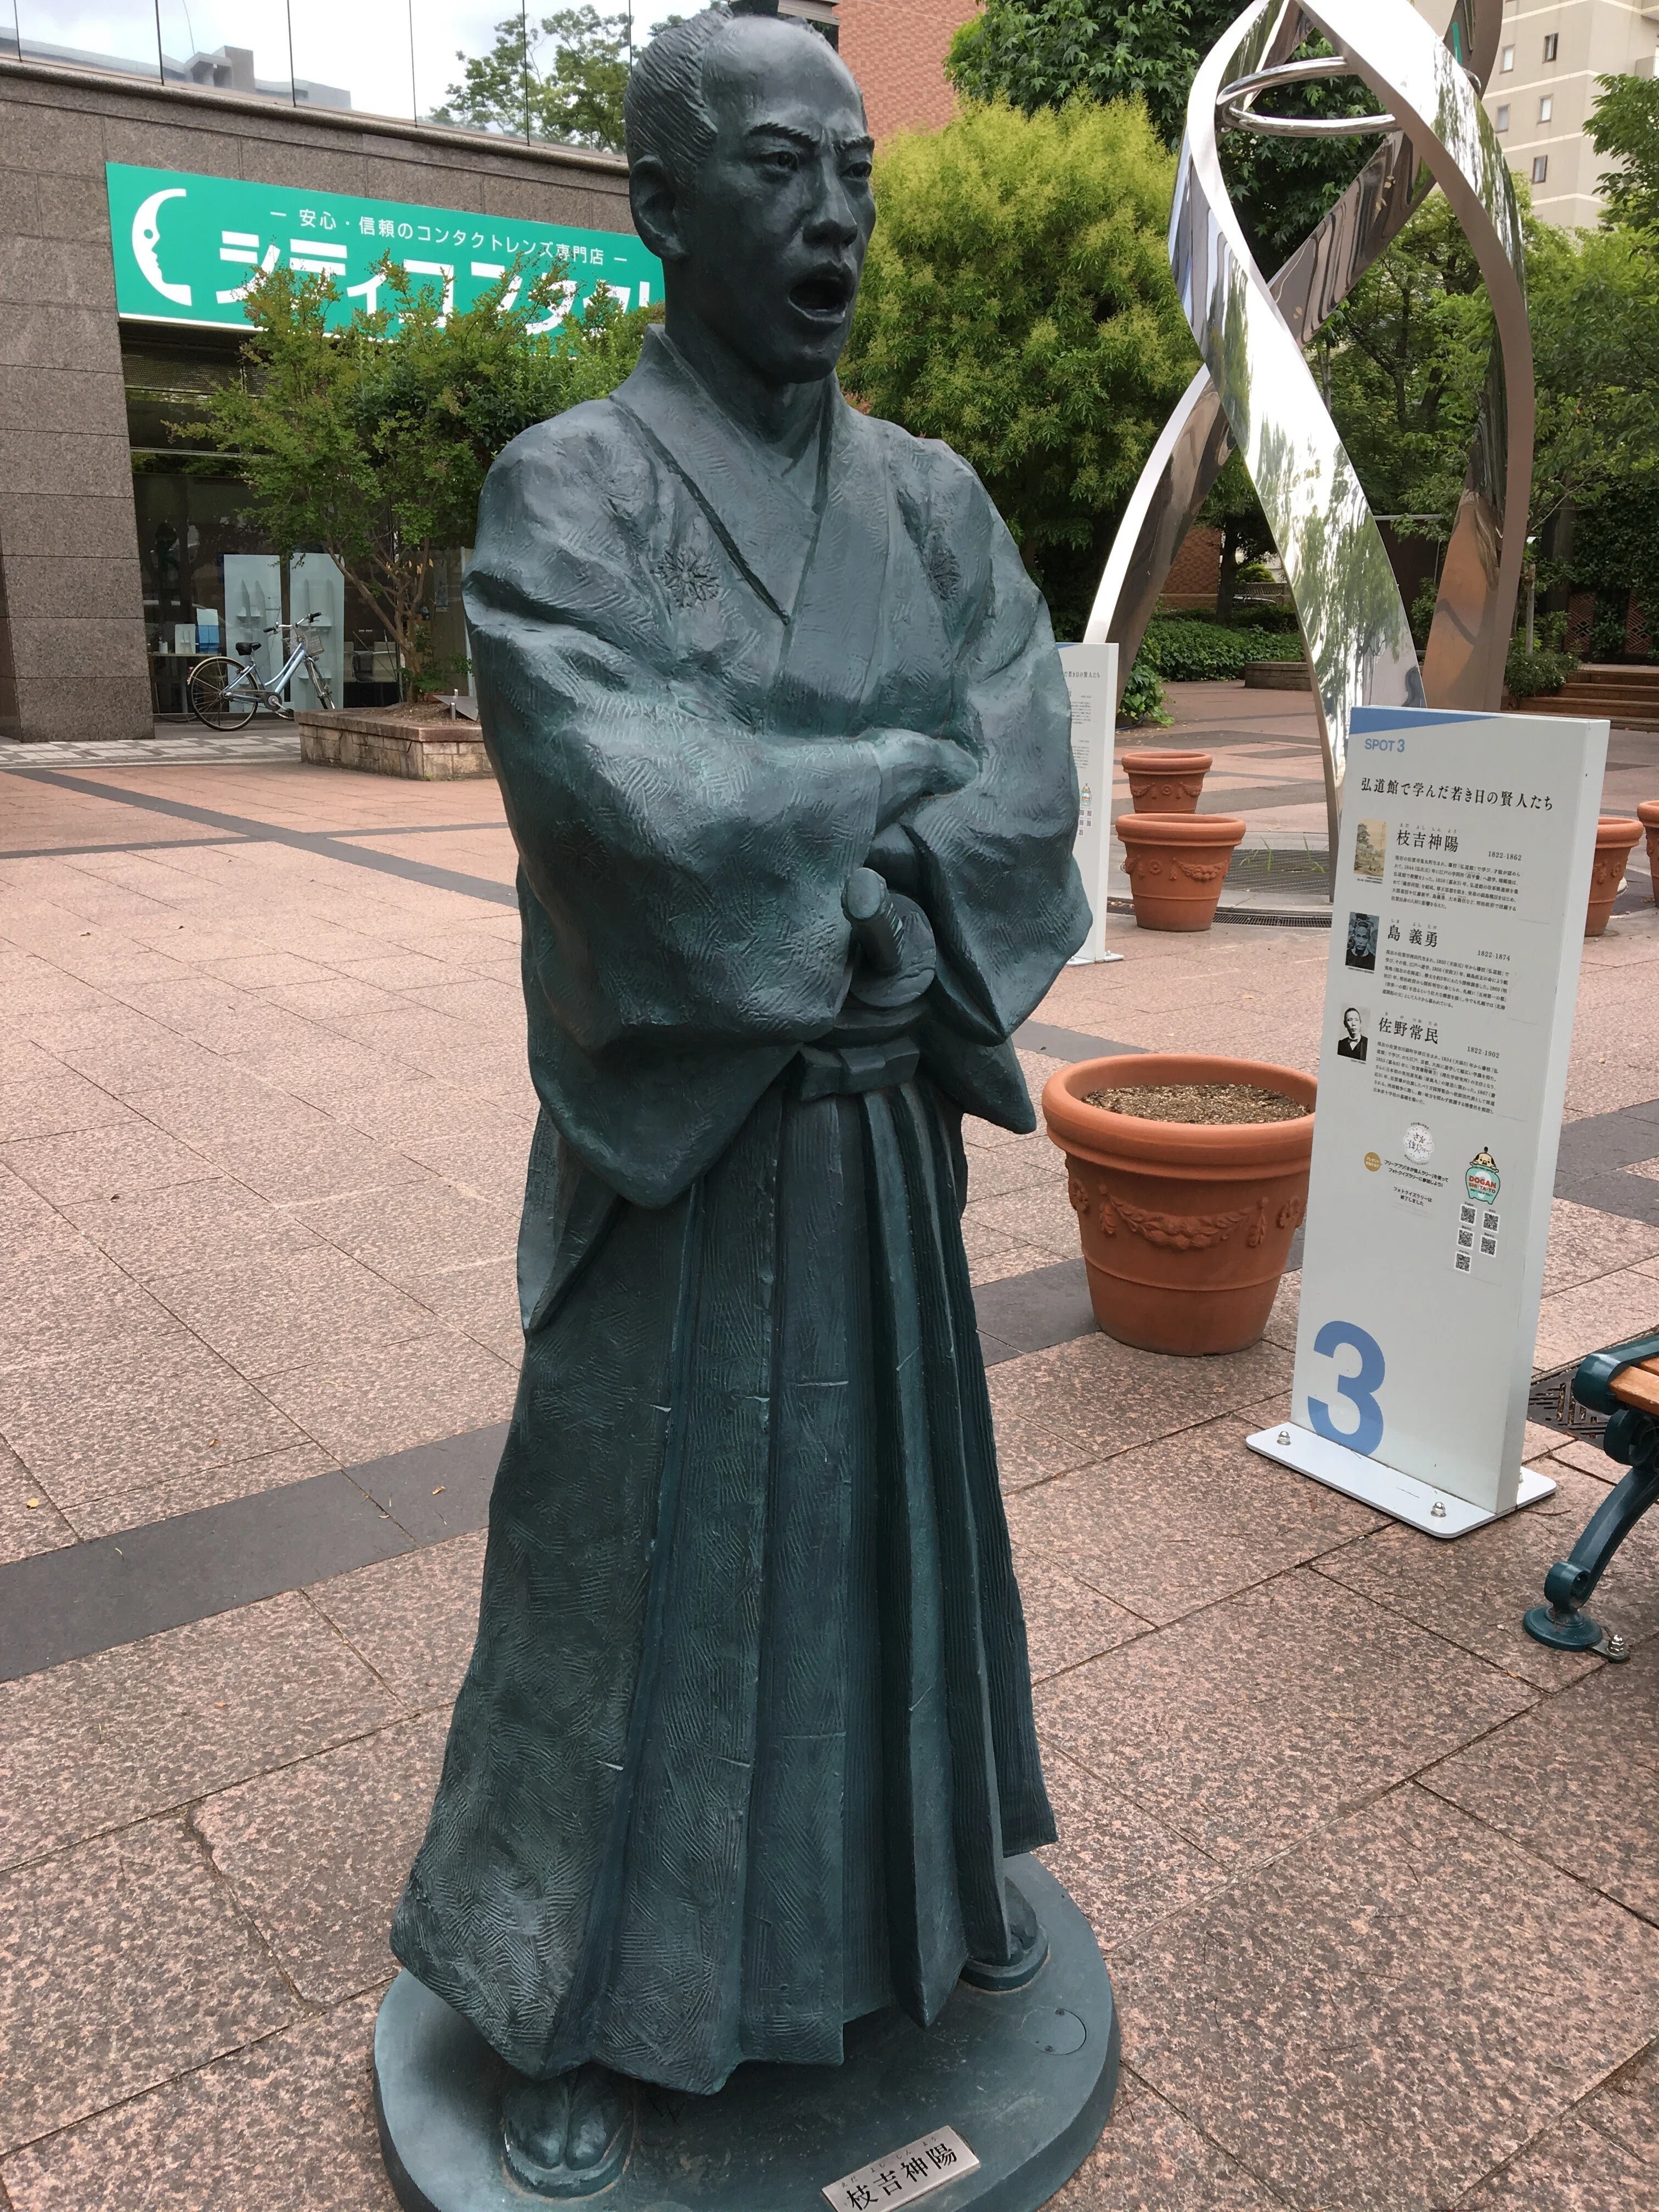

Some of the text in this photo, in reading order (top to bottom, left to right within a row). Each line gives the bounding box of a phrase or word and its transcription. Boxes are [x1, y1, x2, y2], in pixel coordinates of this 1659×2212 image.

[299, 209, 603, 265] 安心・信頼のコンタクトレンズ専門店
[1364, 738, 1406, 753] SPOT 3
[1361, 777, 1553, 811] 弘道館で学んだ若き日の賢人たち
[1396, 829, 1459, 853] 枝吉神陽
[1488, 851, 1522, 861] 1822-1862
[1387, 925, 1438, 948] 島 義勇
[1477, 950, 1510, 961] 1822-1874
[1378, 1017, 1439, 1045] 佐野常民
[1467, 1046, 1500, 1059] 1822-1902
[1469, 1175, 1497, 1188] DOGAN
[1393, 1187, 1432, 1203] フォトクイズラリーは
[1308, 1321, 1385, 1456] 3
[846, 2143, 957, 2211] 枝吉神陽
